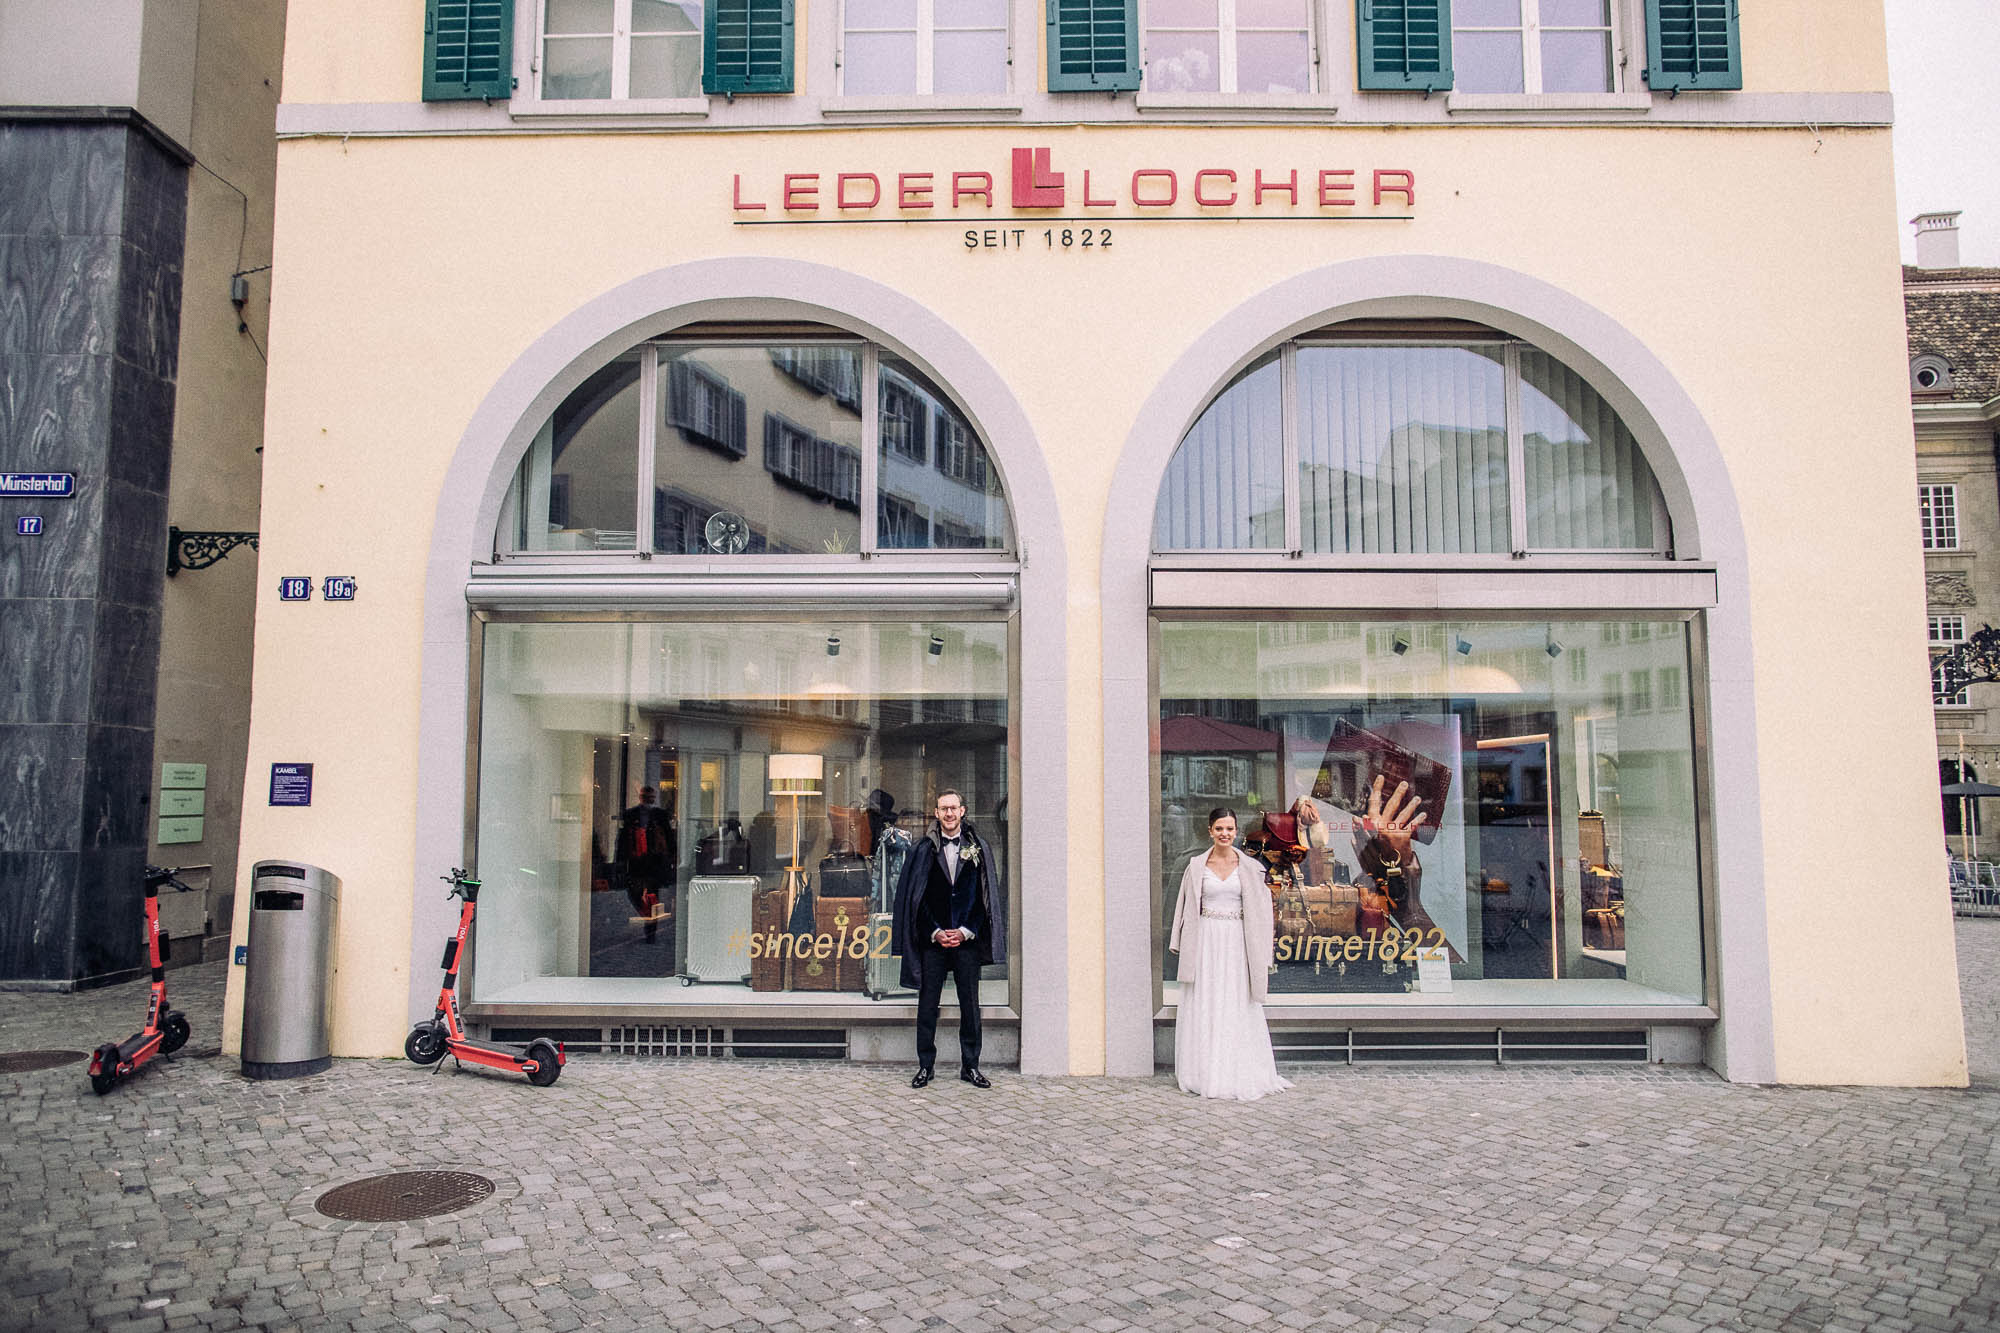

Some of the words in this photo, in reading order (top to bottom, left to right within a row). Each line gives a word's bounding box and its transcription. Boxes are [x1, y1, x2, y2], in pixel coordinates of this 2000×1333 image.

[733, 170, 993, 210] LEDER
[1083, 168, 1415, 207] LOCHER
[965, 229, 1026, 248] SEIT
[1043, 227, 1113, 248] 1822
[0, 475, 67, 491] Münsterhof
[23, 518, 38, 532] 17
[287, 580, 304, 597] 18
[327, 580, 351, 597] 19a
[726, 925, 902, 960] #since182
[1273, 927, 1447, 961] since1822
